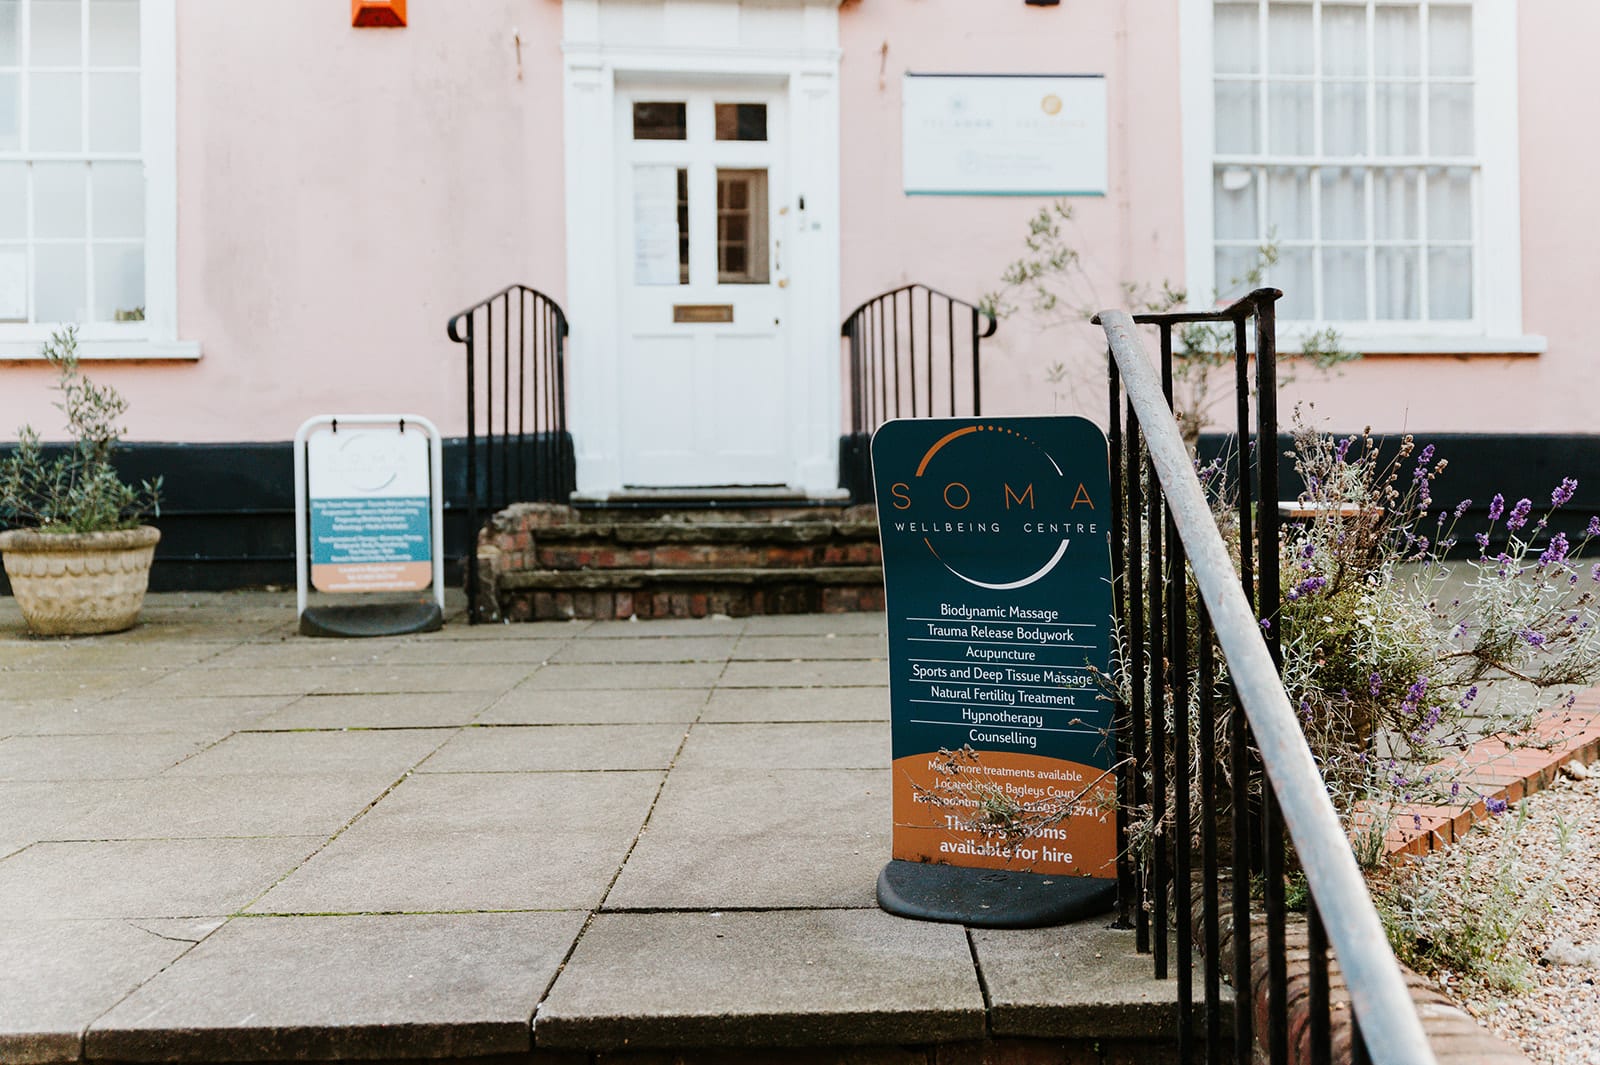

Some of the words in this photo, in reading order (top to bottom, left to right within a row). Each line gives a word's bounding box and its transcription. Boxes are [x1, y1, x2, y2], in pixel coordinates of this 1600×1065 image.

[891, 482, 1095, 510] SOMA
[894, 522, 1000, 533] WELLBEING
[1023, 522, 1097, 534] CENTRE
[940, 603, 1006, 620] Biodynamic
[1009, 605, 1059, 623] Massage
[927, 623, 968, 638] Trauma
[970, 625, 1014, 639] Release
[1016, 626, 1074, 644] Bodywork
[965, 645, 1036, 662] Acupuncture
[912, 664, 947, 679] Sports
[949, 666, 971, 679] and
[973, 667, 1003, 683] Deep
[1005, 668, 1041, 682] Tissue
[1043, 670, 1094, 688] Massage
[930, 685, 971, 700] Natural
[973, 687, 1015, 706] Fertility
[1017, 689, 1076, 706] Treatment
[962, 707, 1043, 728] Hypnotherapy
[969, 729, 1038, 748] Counselling
[957, 765, 982, 775] more
[983, 765, 1035, 779] treatments
[1037, 769, 1083, 782] available
[935, 777, 973, 791] Located
[976, 779, 1004, 792] inside
[1005, 782, 1045, 799] Bagleys
[1046, 786, 1076, 800] Court
[939, 839, 1011, 858] available
[1015, 843, 1039, 860] for
[1042, 846, 1073, 863] hire
